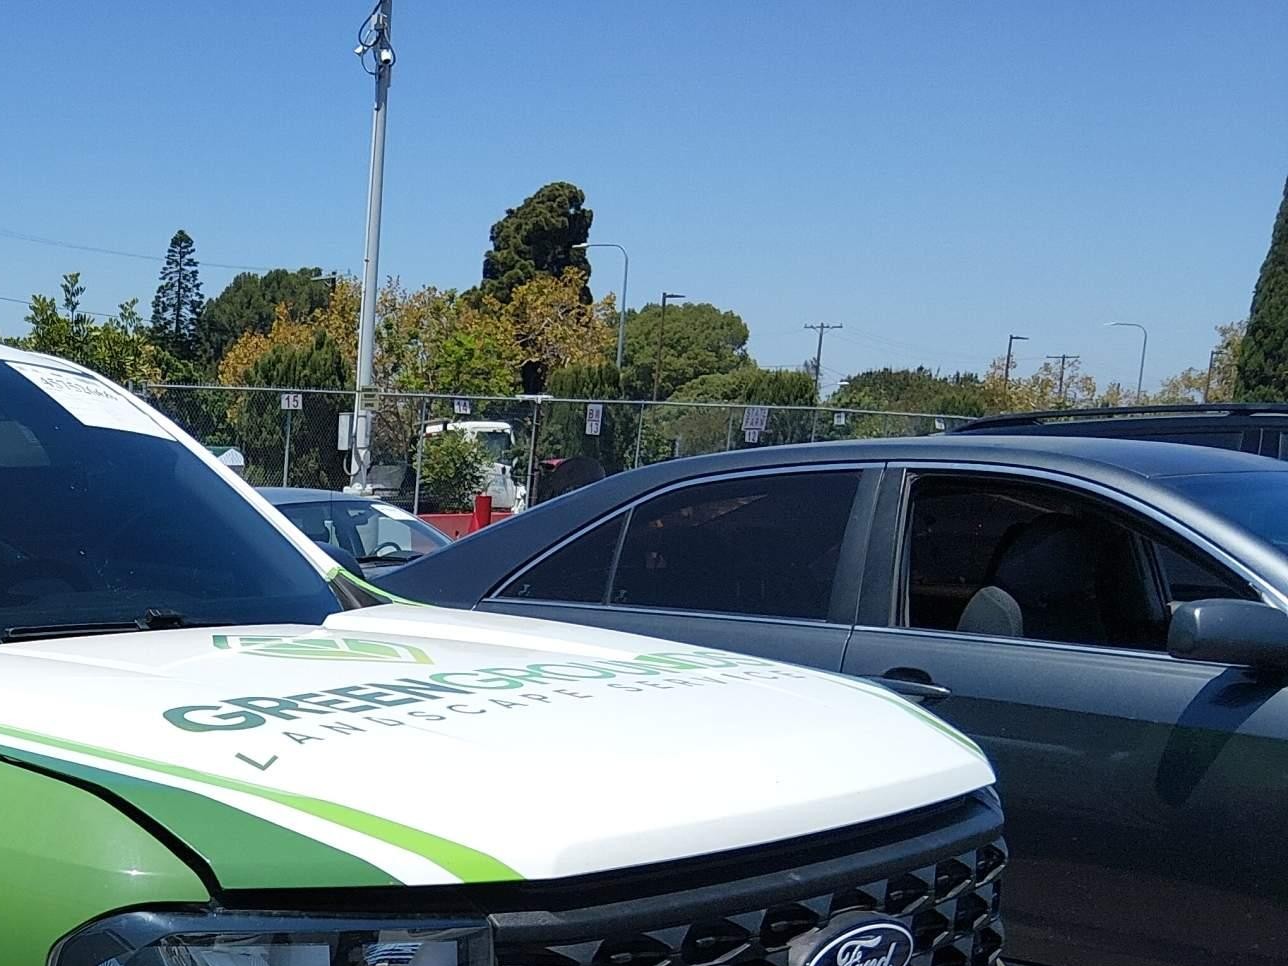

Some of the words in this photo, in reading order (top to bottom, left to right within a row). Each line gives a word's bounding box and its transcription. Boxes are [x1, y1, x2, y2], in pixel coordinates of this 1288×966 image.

[285, 395, 299, 409] 15
[589, 421, 600, 434] 13
[162, 651, 776, 733] GREENGROUNDS
[234, 688, 593, 772] LANDSCAPE
